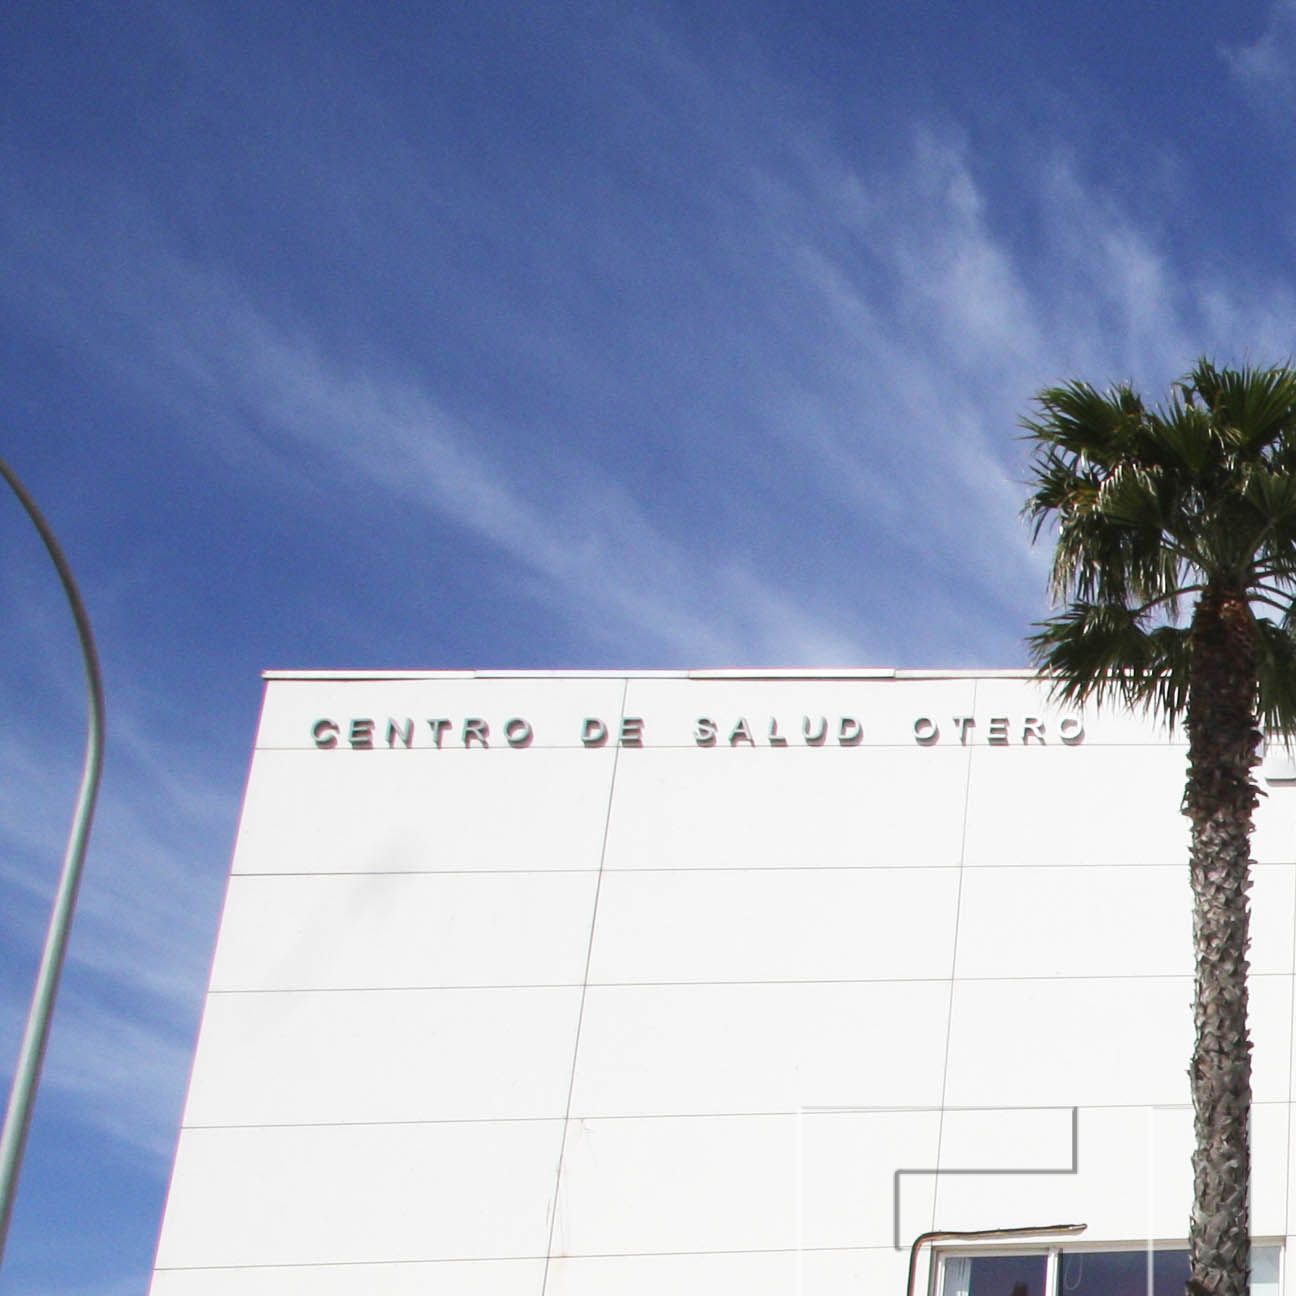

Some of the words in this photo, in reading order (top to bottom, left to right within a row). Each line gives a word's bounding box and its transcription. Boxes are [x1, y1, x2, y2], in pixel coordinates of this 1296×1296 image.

[310, 717, 534, 750] CENTRO
[580, 717, 645, 749] DE
[693, 715, 864, 748] SALUD
[912, 713, 1086, 747] OTERO
